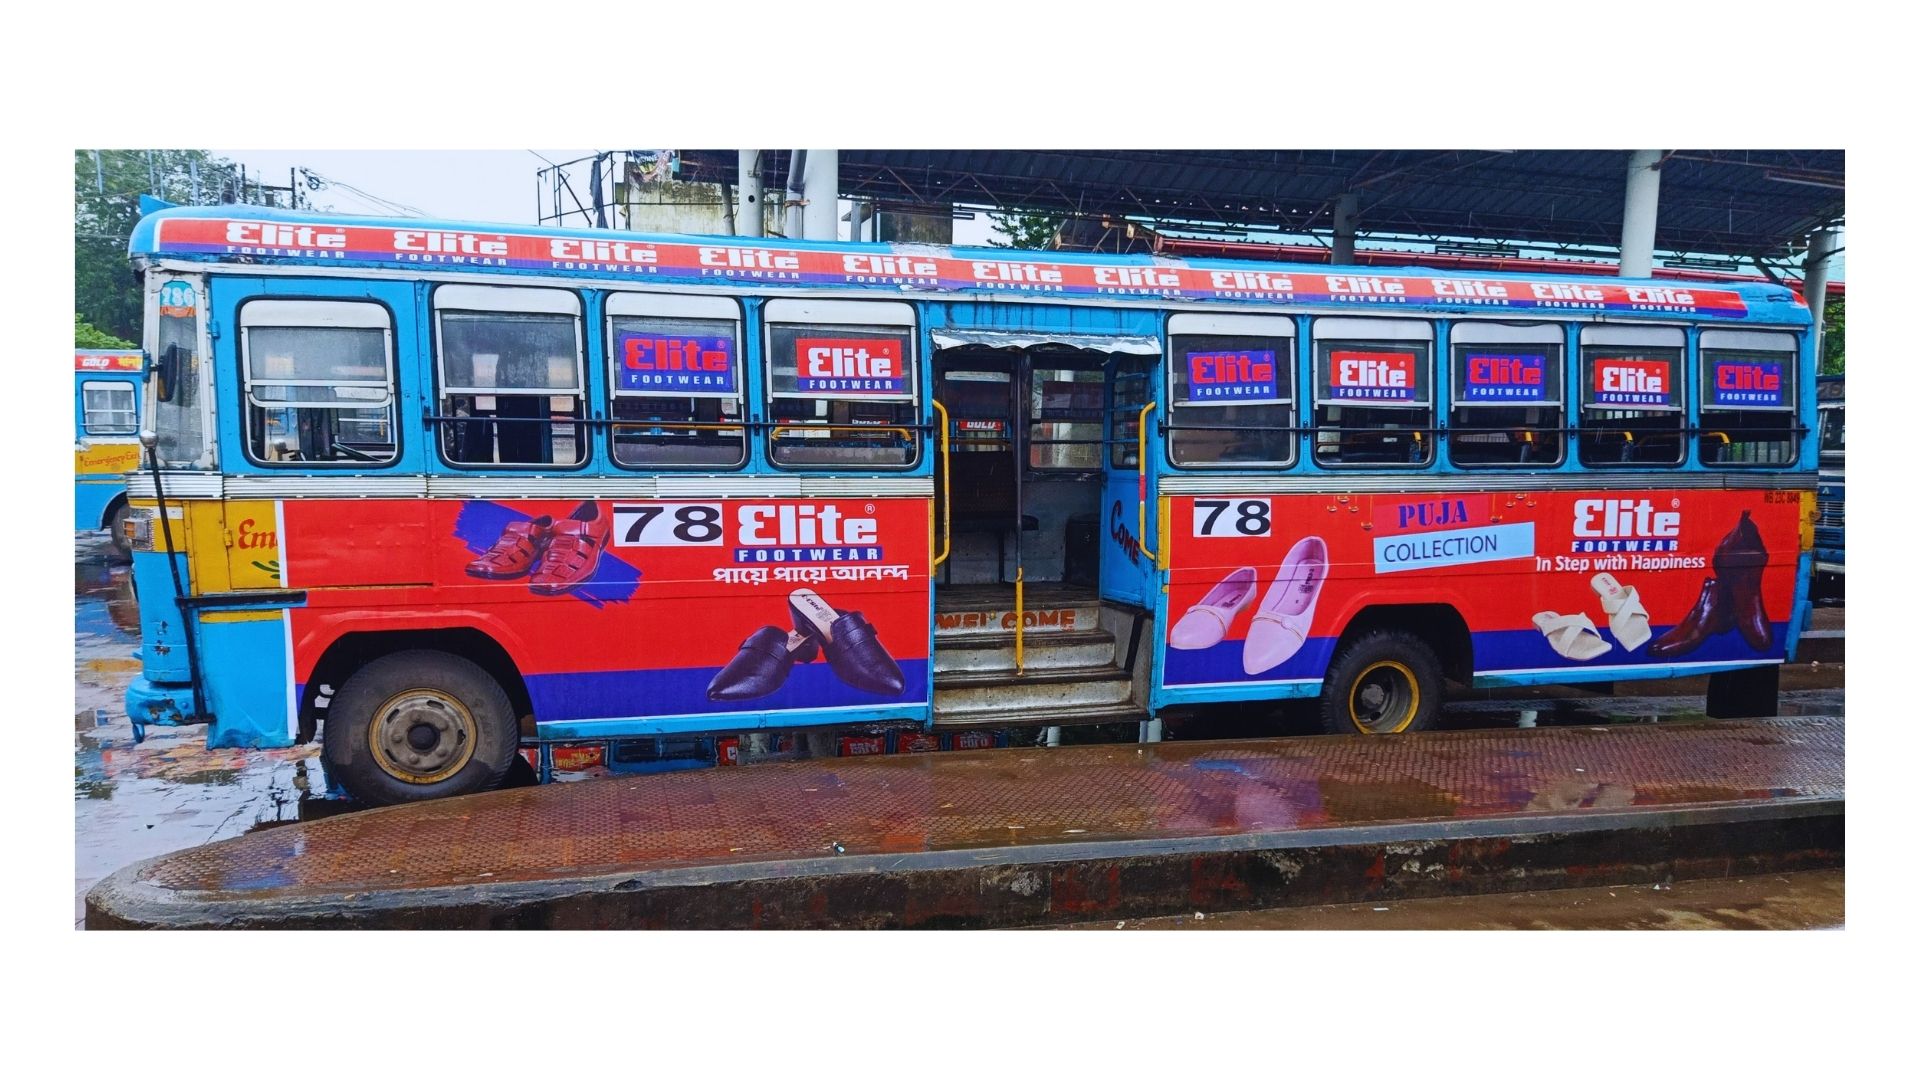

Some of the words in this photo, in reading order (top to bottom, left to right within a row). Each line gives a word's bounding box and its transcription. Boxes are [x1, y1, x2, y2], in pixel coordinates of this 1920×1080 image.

[227, 223, 345, 247] Elite
[394, 231, 507, 254] Elite
[227, 246, 345, 258] FOOTWEAR
[395, 253, 507, 266] FOOTWEAR
[551, 240, 657, 262] Elite
[700, 248, 799, 270] Elite
[552, 262, 657, 272] FOOTWEAR
[702, 269, 799, 279] FOOTWEAR
[843, 255, 937, 276] Elite
[973, 262, 1062, 282] Elite
[846, 275, 938, 284] FOOTWEAR
[976, 282, 1063, 291] FOOTWEAR
[1094, 268, 1179, 287] Elite
[1212, 271, 1292, 290] Elite
[1326, 276, 1404, 294] Elite
[1097, 288, 1180, 296] FOOTWEAR
[1215, 291, 1293, 299] FOOTWEAR
[1432, 279, 1507, 298] Elite
[1531, 283, 1604, 301] Elite
[1627, 287, 1694, 305] Elite
[1330, 294, 1405, 302] FOOTWEAR
[1437, 297, 1509, 305] FOOTWEAR
[1536, 300, 1605, 308] FOOTWEAR
[1631, 304, 1697, 312] FOOTWEAR
[624, 338, 728, 371] Elite
[808, 348, 891, 377] Elite
[1192, 355, 1272, 384] Elite
[1340, 360, 1406, 386] Elite
[1469, 358, 1542, 384] Elite
[1718, 366, 1779, 390] Elite
[631, 374, 724, 385] FOOTWEAR
[810, 380, 892, 390] FOOTWEAR
[1602, 366, 1662, 392] Elite
[1196, 386, 1270, 396] FOOTWEAR
[1340, 388, 1406, 398] FOOTWEAR
[1472, 387, 1538, 396] FOOTWEAR
[1602, 394, 1662, 403] FOOTWEAR
[1720, 392, 1777, 401] FOOTWEAR
[1194, 500, 1271, 536] 78
[1398, 500, 1468, 528] PUJA
[1573, 499, 1680, 537] Elite
[614, 506, 722, 542] 78
[738, 504, 877, 546] Elite
[1384, 534, 1497, 564] COLLECTION
[1572, 540, 1678, 552] FOOTWEAR
[739, 549, 878, 562] FOOTWEAR
[1536, 556, 1551, 572] In
[1556, 555, 1590, 574] Step
[1594, 554, 1627, 570] with
[1632, 553, 1706, 572] Happiness
[713, 567, 768, 586] পায়ে
[774, 566, 826, 584] পায়ে
[830, 564, 910, 582] আনন্দ
